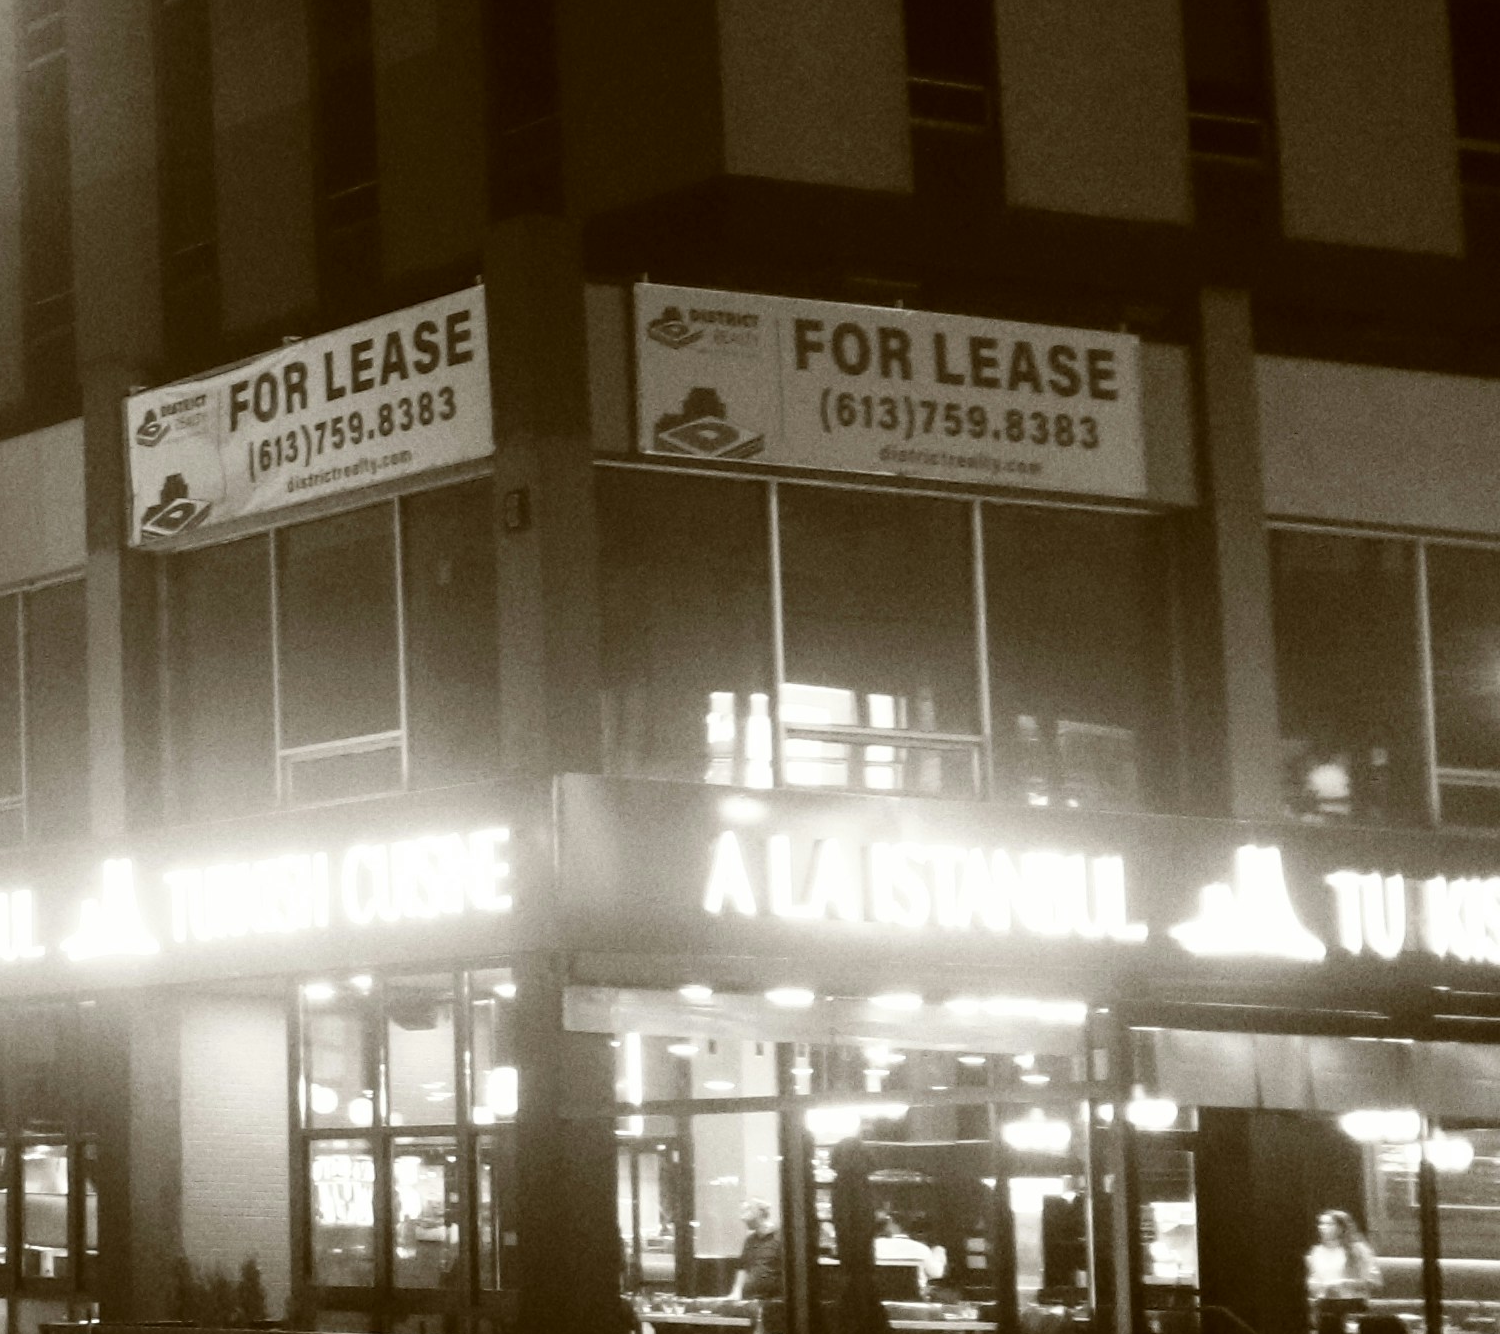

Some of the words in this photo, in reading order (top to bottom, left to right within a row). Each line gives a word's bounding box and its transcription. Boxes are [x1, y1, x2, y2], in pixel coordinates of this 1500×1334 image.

[689, 308, 760, 328] DISTRICT
[794, 317, 913, 381] FOR
[934, 331, 1119, 401] LEASE
[229, 361, 309, 433] FOR
[323, 309, 474, 402] LEASE
[247, 385, 457, 484] (613)759.8383
[819, 387, 1100, 450] (613)759.8383
[704, 830, 757, 916] A
